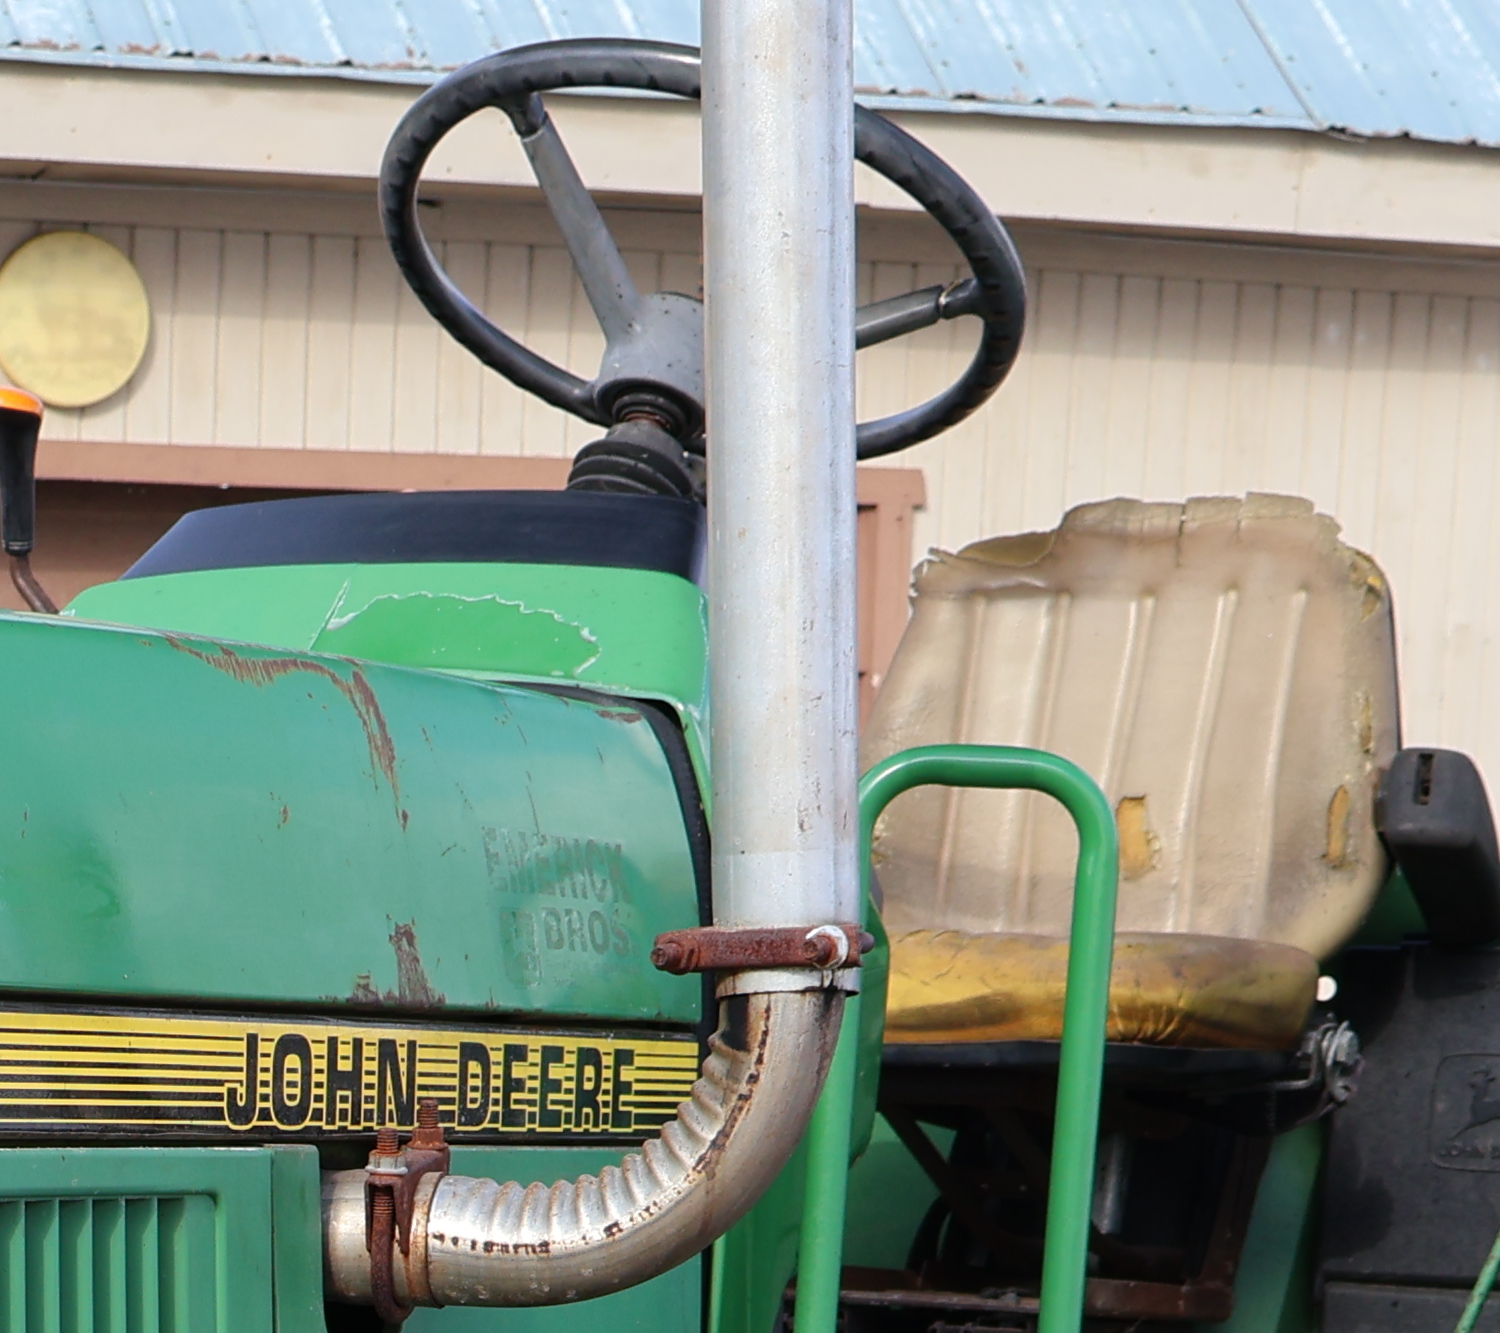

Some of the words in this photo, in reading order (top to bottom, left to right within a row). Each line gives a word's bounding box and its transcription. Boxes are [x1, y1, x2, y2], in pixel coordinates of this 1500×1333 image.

[481, 825, 633, 904] EMERICK
[224, 1031, 418, 1131] JOHN
[458, 1040, 636, 1133] DEERE
